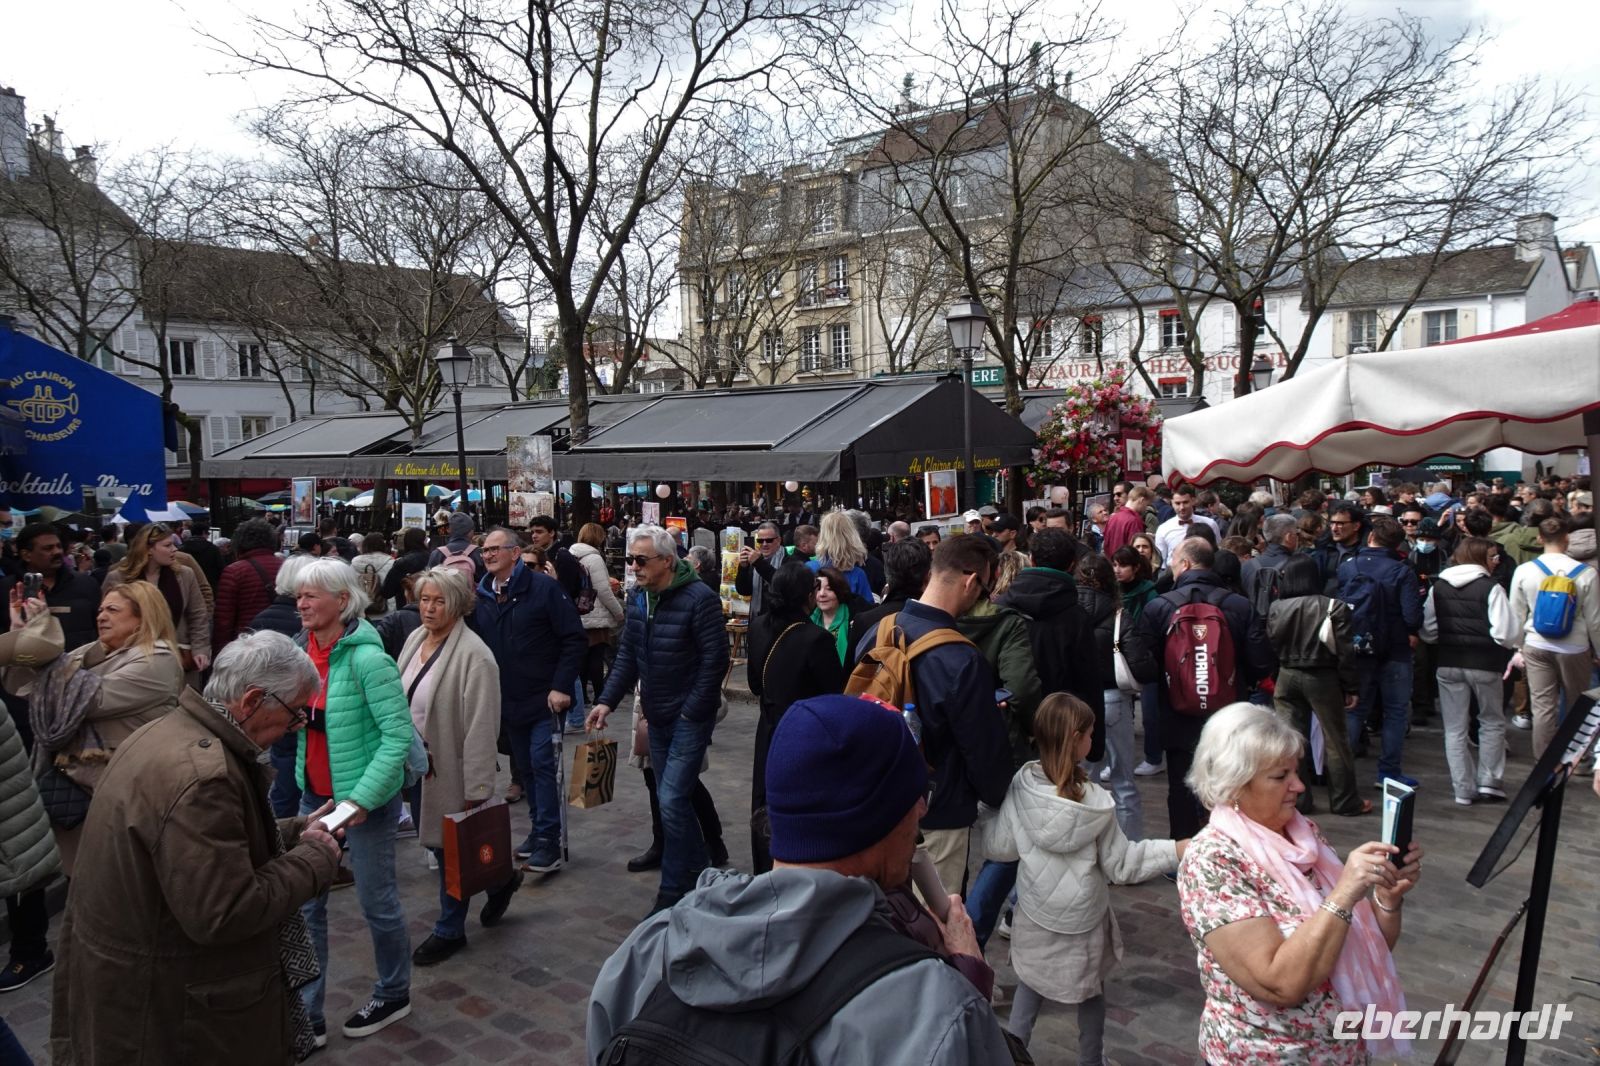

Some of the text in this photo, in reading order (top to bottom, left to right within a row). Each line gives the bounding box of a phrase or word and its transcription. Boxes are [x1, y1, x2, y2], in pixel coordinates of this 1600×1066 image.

[963, 368, 999, 383] ERE
[1016, 351, 1288, 380] ESTAURA HEZ EUGE
[10, 370, 76, 390] AU CLAIRON
[24, 417, 82, 441] CHASSEURS
[440, 462, 475, 476] Chassrs
[908, 454, 1000, 474] Au Clairon des hasseurs
[0, 472, 74, 495] ocktails
[1195, 643, 1208, 695] TORINO
